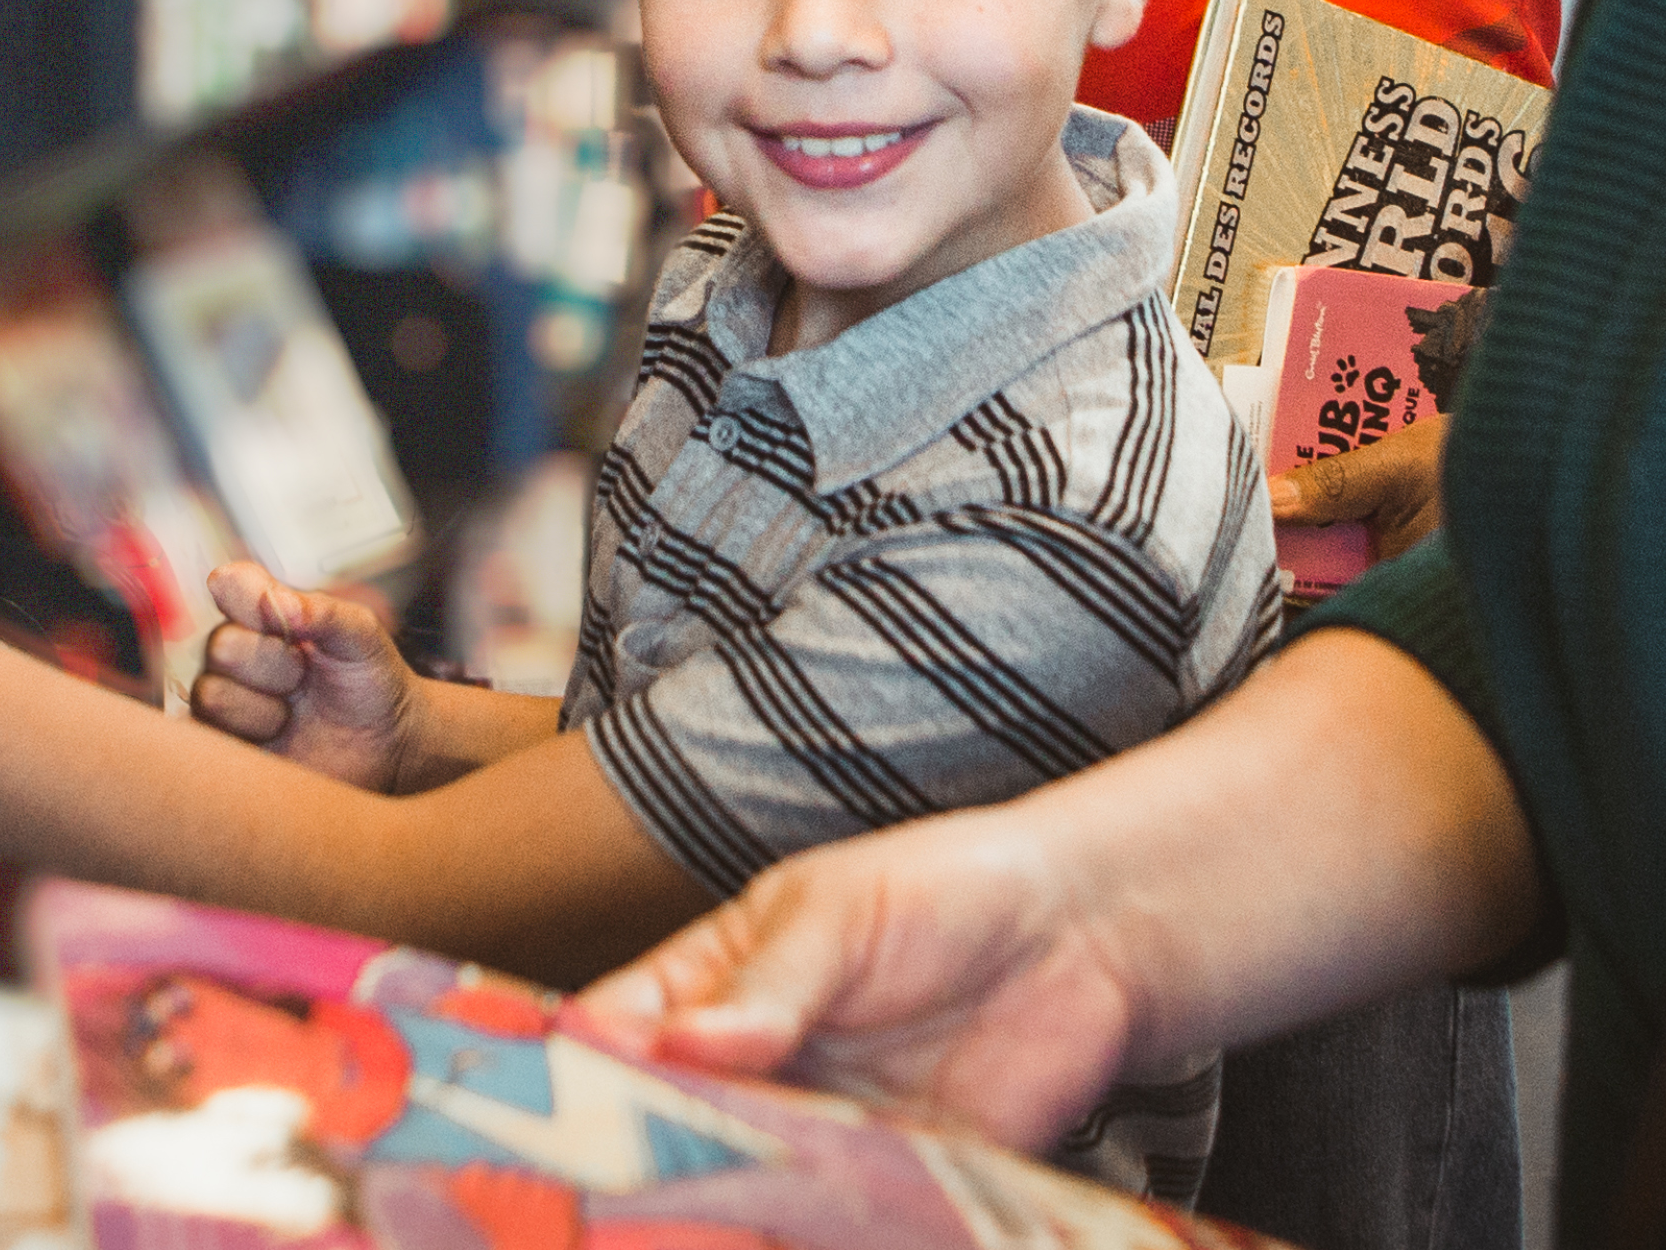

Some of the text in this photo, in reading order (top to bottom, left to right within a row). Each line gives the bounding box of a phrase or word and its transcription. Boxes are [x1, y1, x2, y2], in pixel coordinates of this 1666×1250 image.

[1204, 201, 1240, 284] DES
[1224, 9, 1284, 200] RECORDS
[1359, 96, 1462, 279] RLD
[1430, 109, 1503, 285] ORDS
[1353, 366, 1402, 450] INQ
[1402, 388, 1420, 427] QUE
